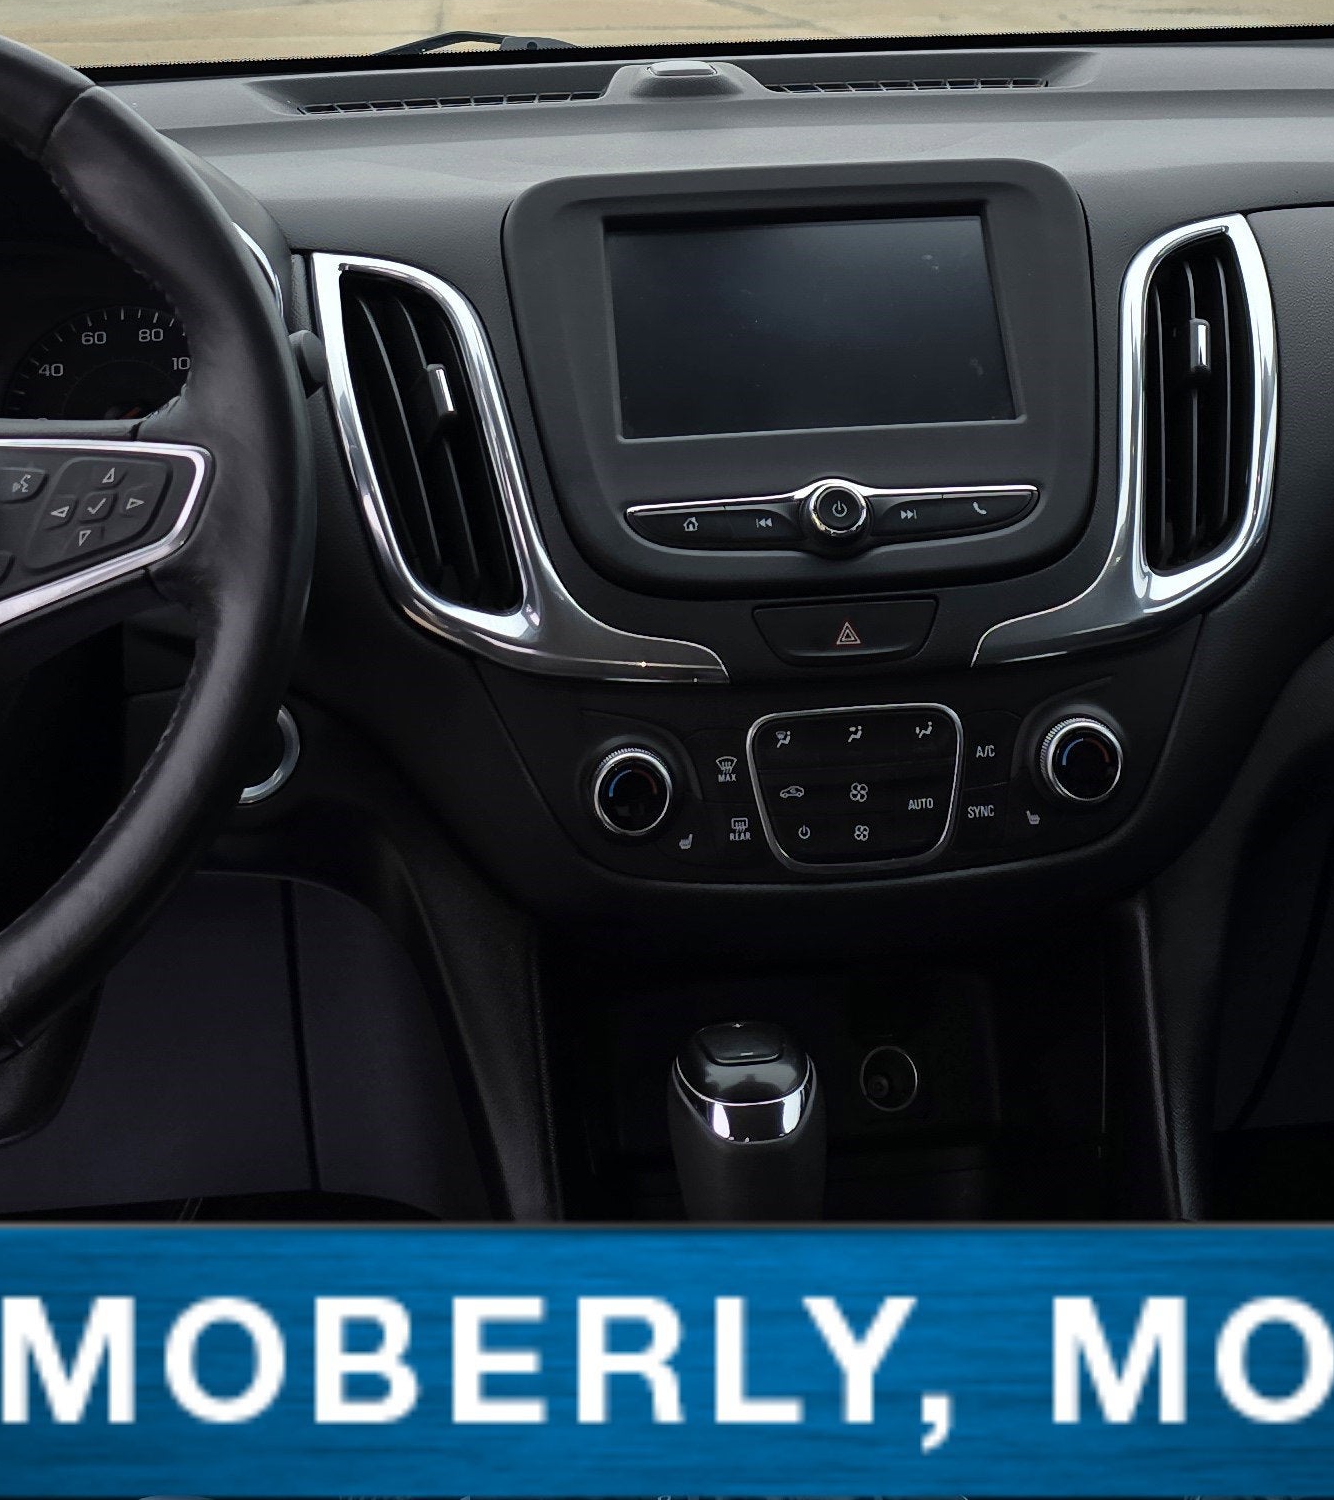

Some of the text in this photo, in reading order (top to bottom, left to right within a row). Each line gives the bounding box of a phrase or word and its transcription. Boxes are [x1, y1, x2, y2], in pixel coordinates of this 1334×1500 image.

[81, 331, 107, 345] 60
[139, 328, 164, 342] 80
[38, 363, 64, 377] 40
[975, 744, 996, 759] A/C
[717, 773, 737, 783] MAX
[907, 797, 934, 811] AUTO
[967, 804, 996, 819] SYNC
[729, 832, 752, 841] REAR
